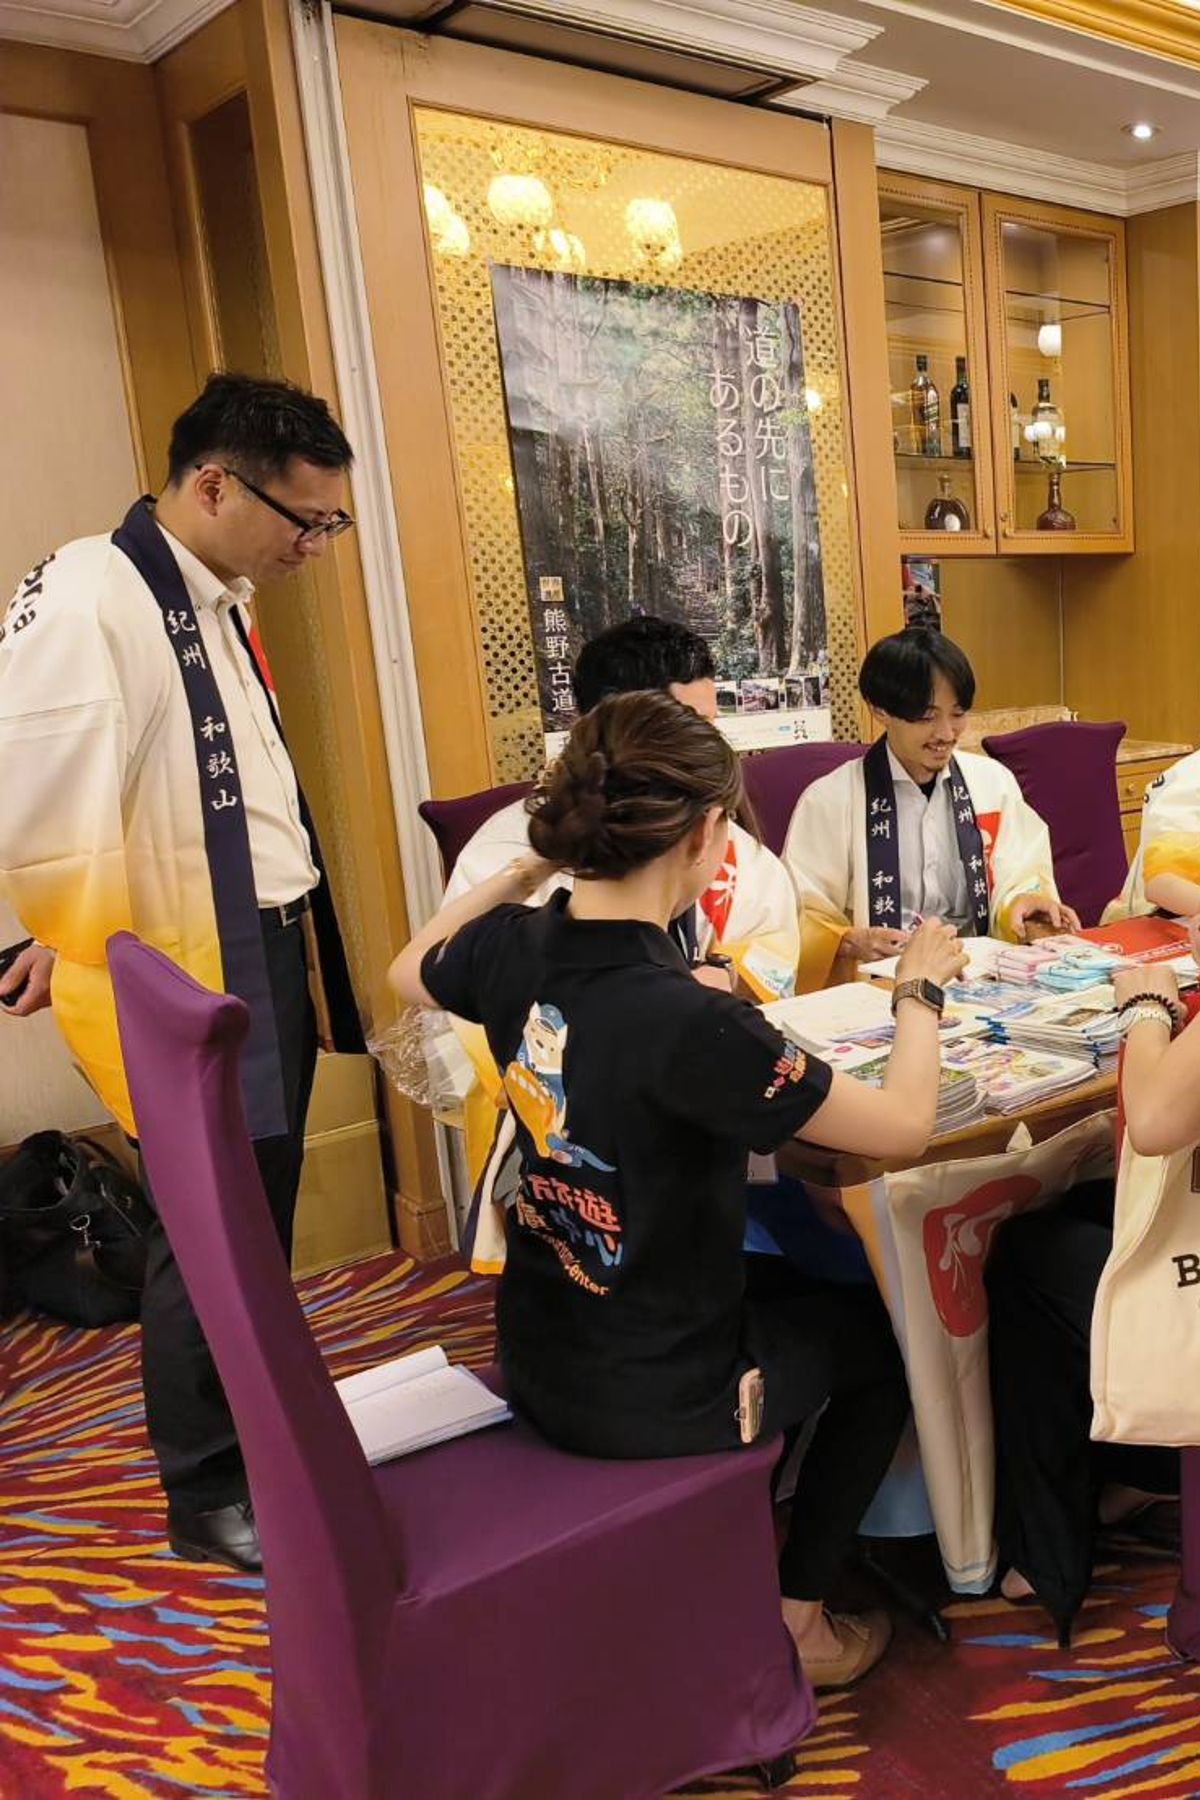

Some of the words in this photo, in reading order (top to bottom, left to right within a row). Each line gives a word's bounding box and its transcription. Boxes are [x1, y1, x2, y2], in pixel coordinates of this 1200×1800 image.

[708, 370, 754, 548] あるもの
[744, 325, 789, 501] 道の先に
[166, 610, 206, 669] 紀州
[200, 716, 238, 811] 和歌山
[543, 608, 576, 713] 熊野古道
[870, 798, 892, 839] 紀州
[871, 870, 896, 929] 和歌
